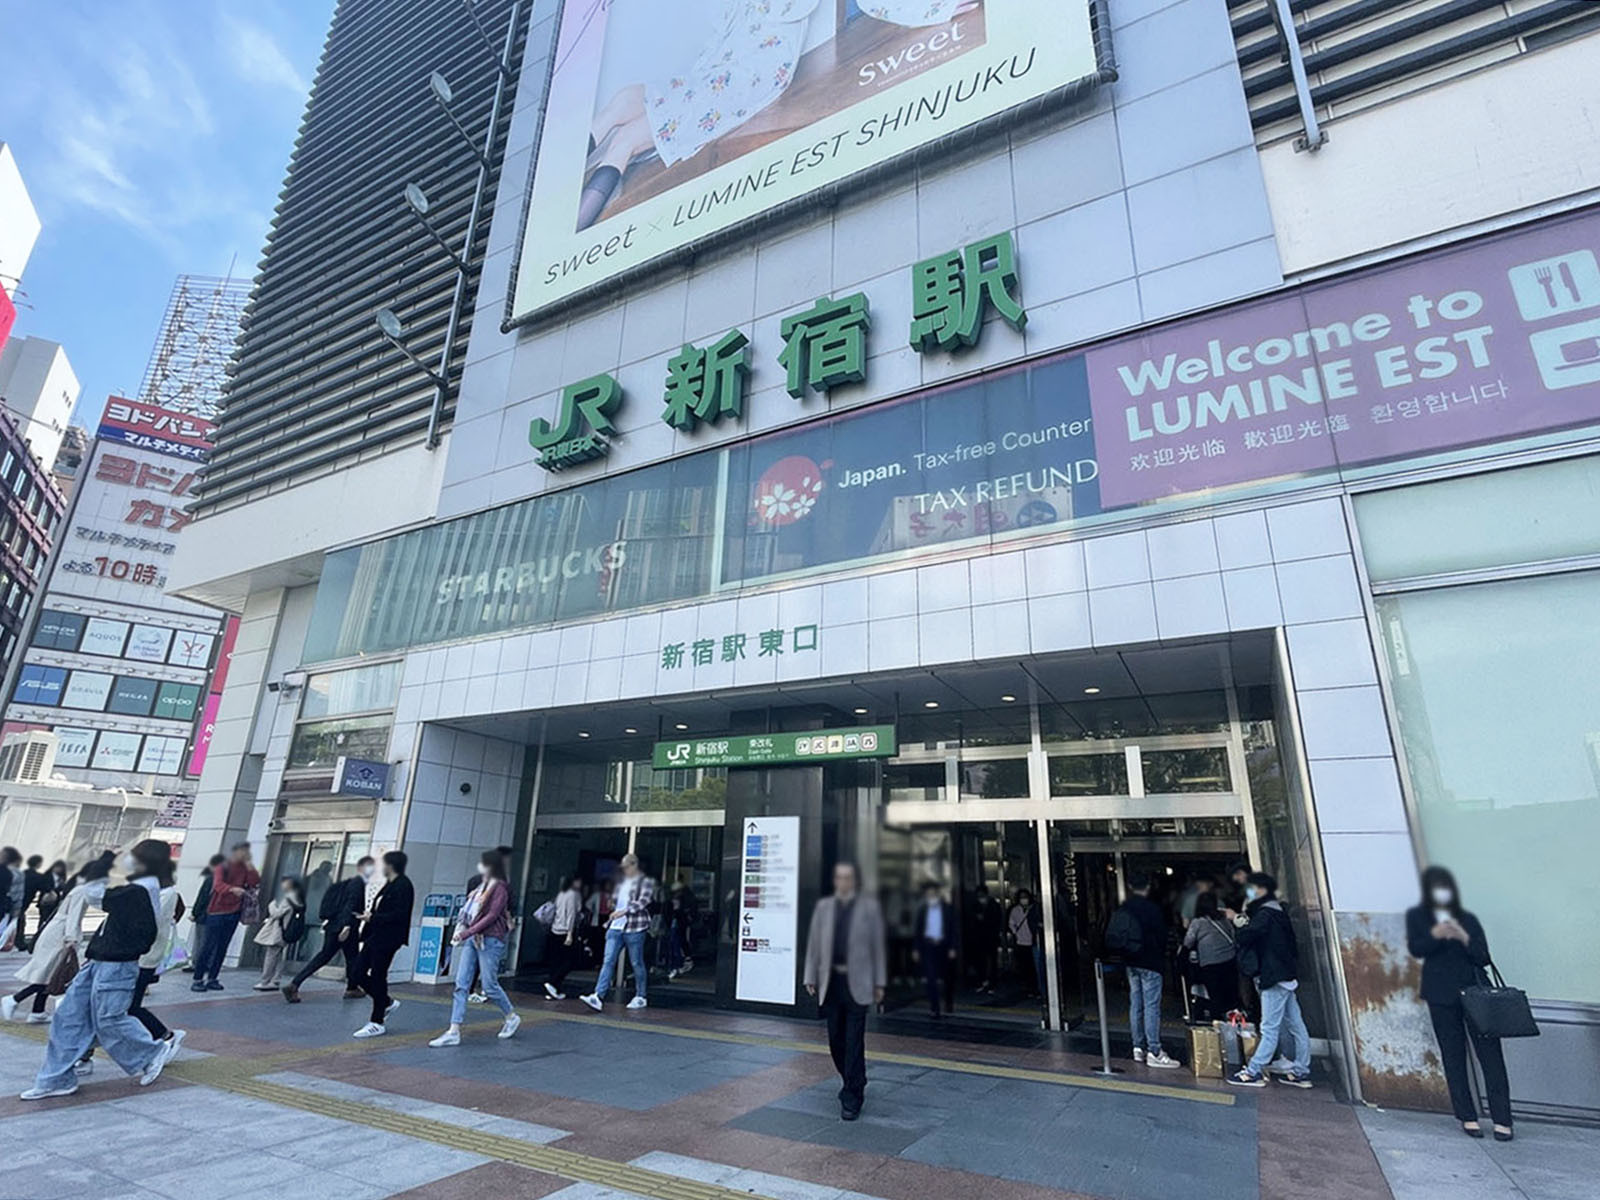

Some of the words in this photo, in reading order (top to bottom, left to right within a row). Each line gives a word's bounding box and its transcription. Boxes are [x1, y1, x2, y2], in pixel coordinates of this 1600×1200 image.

[858, 21, 968, 87] sweet
[544, 222, 638, 286] sweet
[672, 160, 785, 228] LUMINE
[790, 131, 850, 176] EST
[856, 47, 1037, 146] SHINJUKU
[529, 372, 624, 446] JR
[660, 230, 1028, 433] 新宿駅
[1117, 312, 1392, 397] Welcome
[1408, 290, 1484, 329] to
[1125, 358, 1358, 442] LUMINE
[1374, 325, 1494, 389] EST
[124, 431, 205, 458] マルチメディ
[838, 462, 907, 489] Japan.
[914, 440, 996, 471] Tax-free
[1002, 418, 1093, 451] Counter
[1129, 438, 1226, 472] 欢迎光临
[1244, 413, 1350, 450] 歡迎光臨
[1370, 379, 1509, 425] 환영합니다
[914, 485, 967, 515] TAX
[977, 458, 1099, 503] REFUND
[437, 540, 627, 604] STARBUCKS
[661, 624, 818, 670] 新宿駅東口
[667, 744, 691, 760] JR
